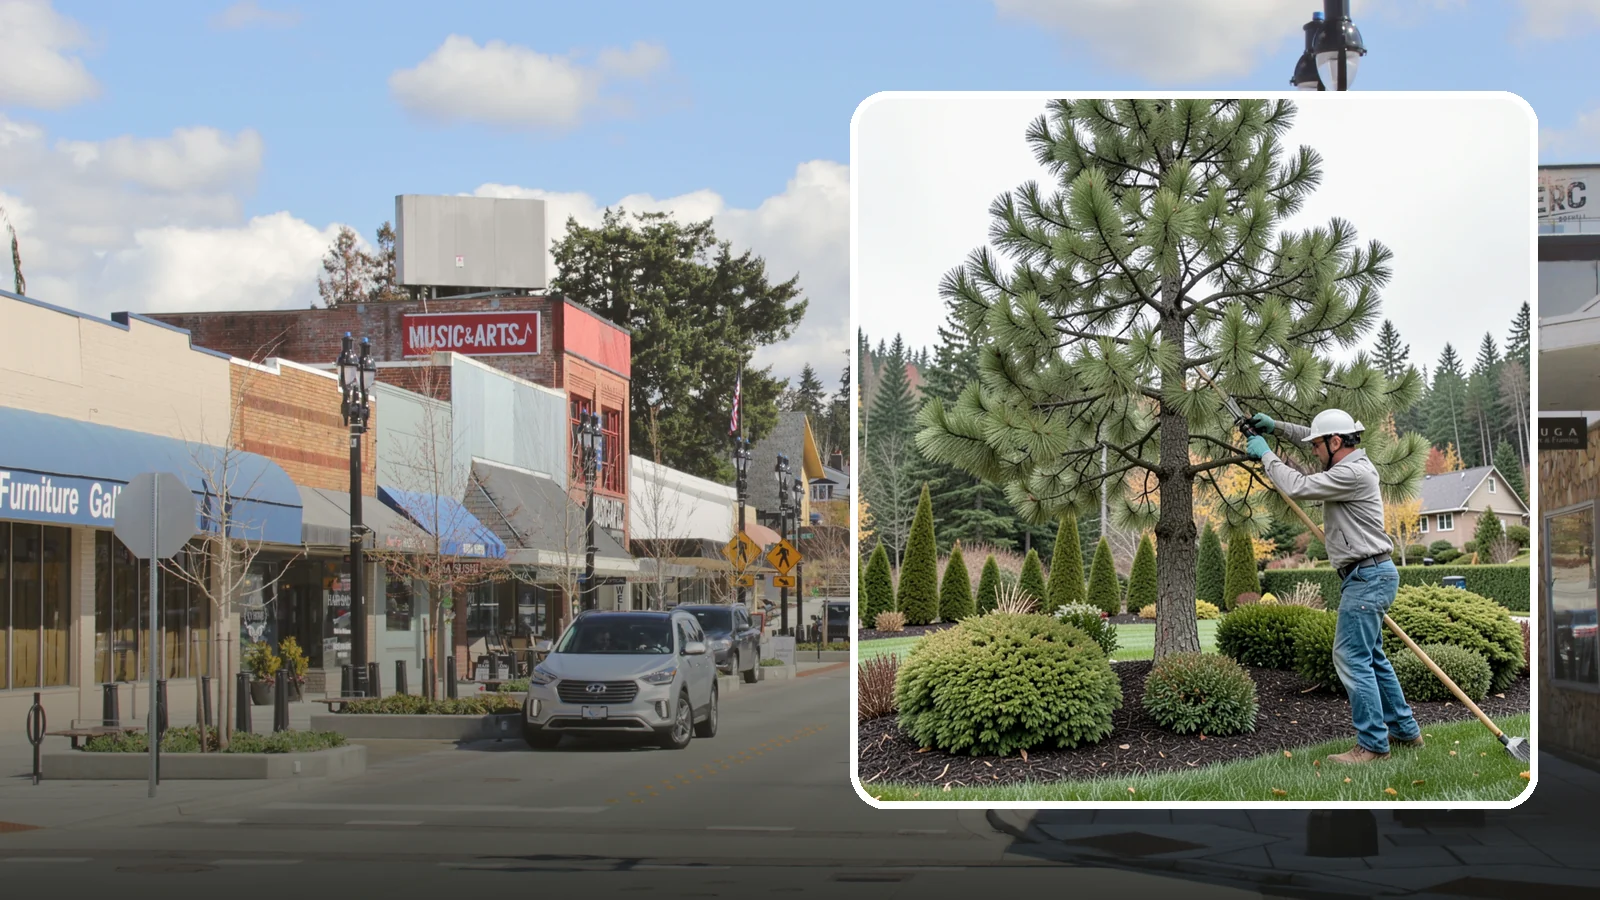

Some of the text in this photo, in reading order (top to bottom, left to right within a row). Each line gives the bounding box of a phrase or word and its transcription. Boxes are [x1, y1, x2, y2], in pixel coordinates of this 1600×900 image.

[409, 323, 519, 348] MUSIC&ARTS
[0, 472, 122, 518] Furniture Gal
